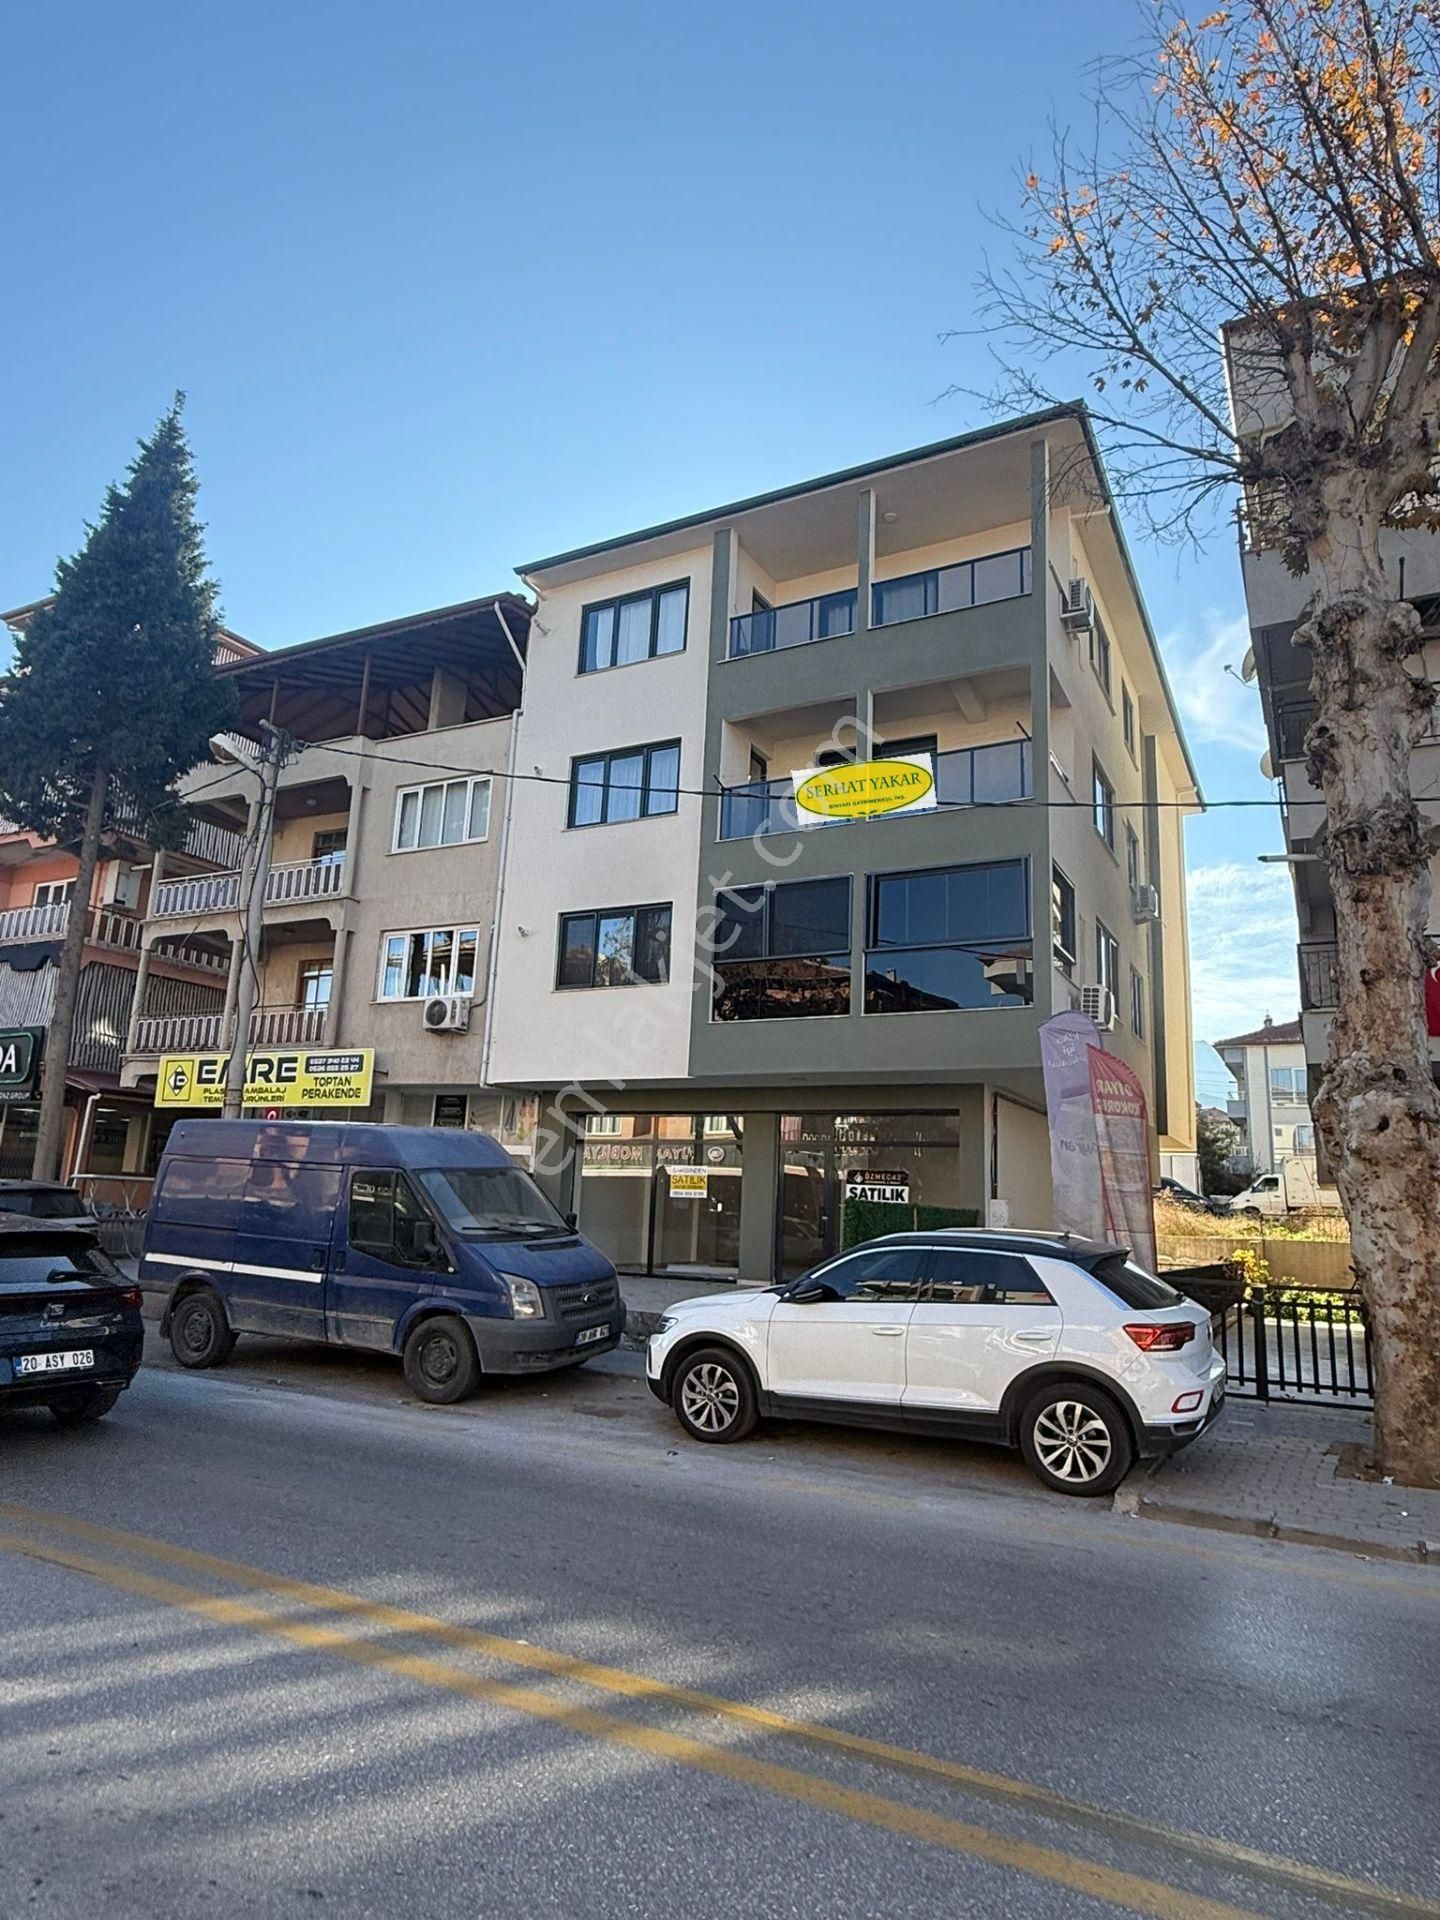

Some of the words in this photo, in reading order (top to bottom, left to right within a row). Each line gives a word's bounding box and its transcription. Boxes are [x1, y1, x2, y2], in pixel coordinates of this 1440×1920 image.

[806, 779, 868, 799] SERHAT
[869, 772, 922, 790] YAKAR
[313, 1076, 352, 1087] TOPTAN
[244, 1086, 287, 1094] AMBALAJ
[301, 1087, 362, 1099] PERAKENDE
[671, 1175, 706, 1185] SATILIK
[848, 1186, 906, 1202] SATILIK
[23, 1357, 37, 1371] 20
[45, 1354, 65, 1369] ASY
[72, 1352, 93, 1366] 026
